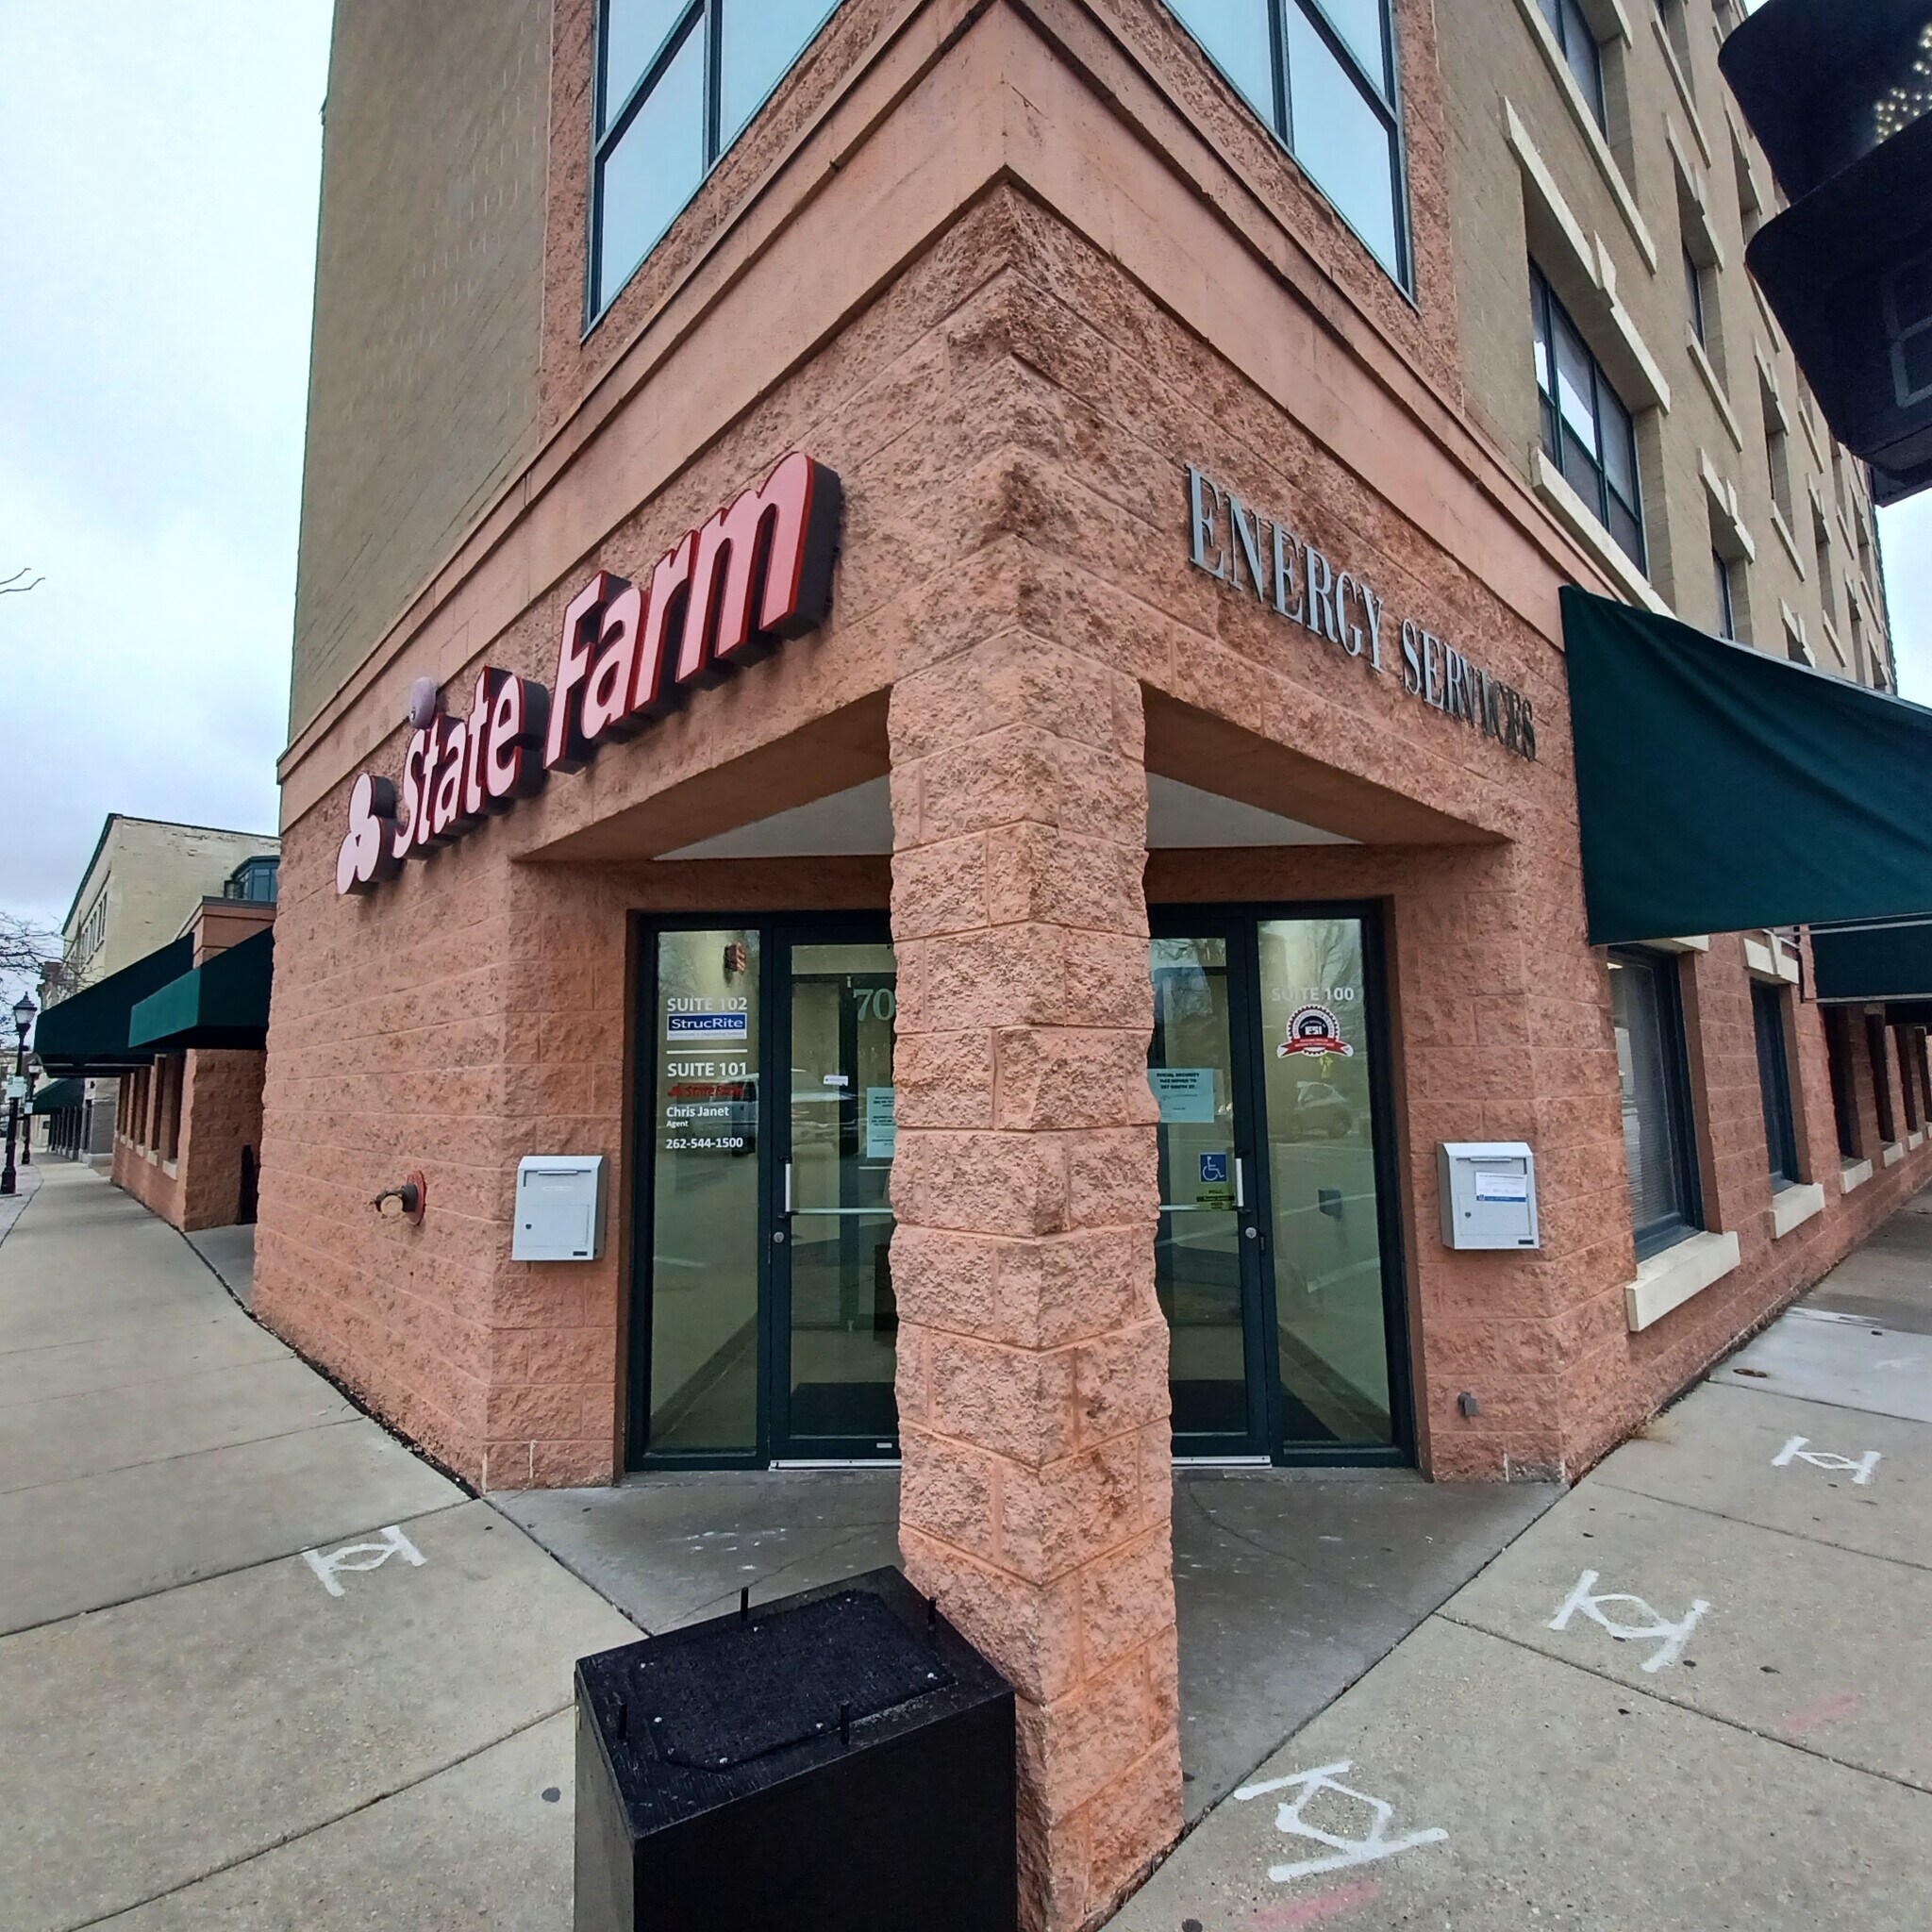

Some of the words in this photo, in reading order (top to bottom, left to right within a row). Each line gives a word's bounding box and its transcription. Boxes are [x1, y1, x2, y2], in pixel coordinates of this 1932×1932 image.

[1185, 462, 1384, 675] ENERGY
[1401, 618, 1538, 762] SERVICES
[391, 666, 525, 858] State
[544, 451, 815, 771] Farm
[1272, 987, 1321, 1001] SUITE
[1324, 987, 1355, 1001] 100
[667, 997, 713, 1011] SUITE
[719, 997, 748, 1010] 102
[672, 1018, 743, 1029] StrucRite
[667, 1062, 715, 1076] SUITE
[719, 1062, 747, 1075] 101
[666, 1107, 696, 1117] Chris
[697, 1106, 729, 1117] Janet
[666, 1120, 689, 1128] Agent
[665, 1138, 743, 1149] 262-544-1500
